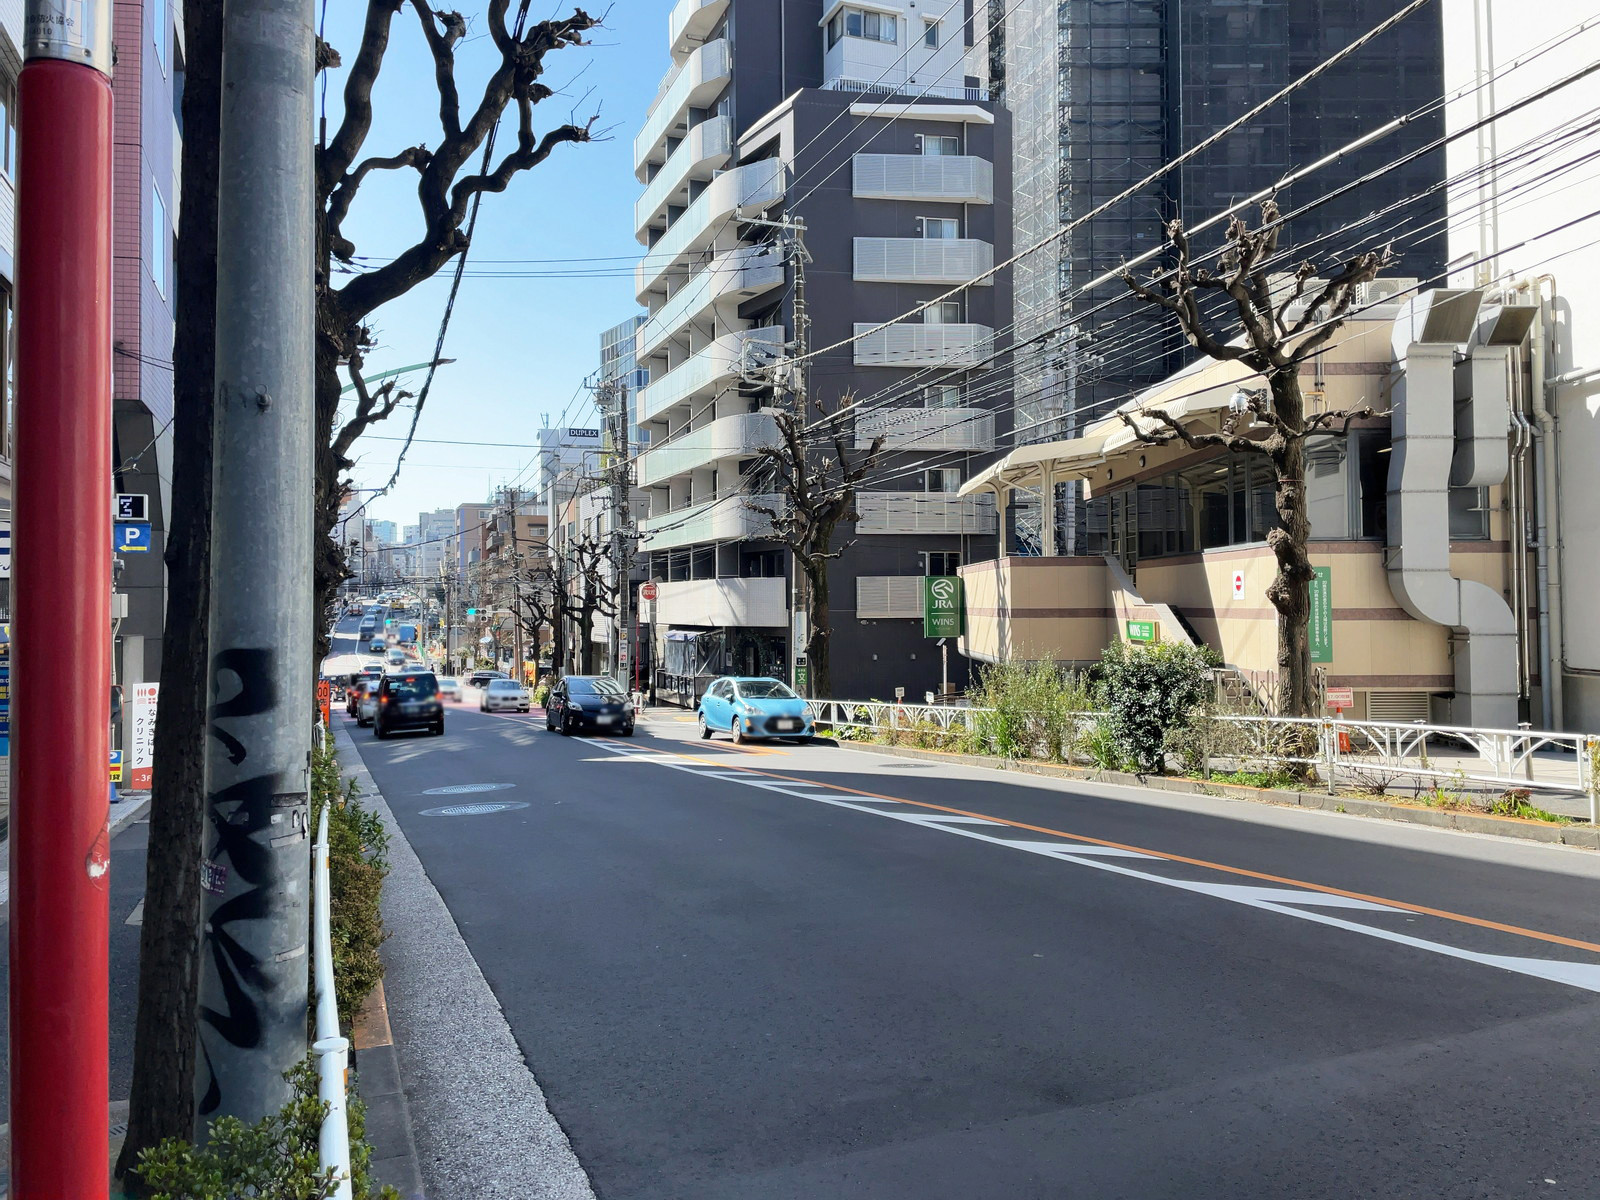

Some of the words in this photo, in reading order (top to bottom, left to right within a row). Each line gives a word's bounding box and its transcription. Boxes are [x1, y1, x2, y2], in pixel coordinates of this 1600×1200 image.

[570, 429, 597, 437] DUPLEX
[125, 527, 141, 545] P
[932, 599, 954, 609] JRA
[932, 618, 955, 626] WINS
[136, 717, 144, 765] クリニック
